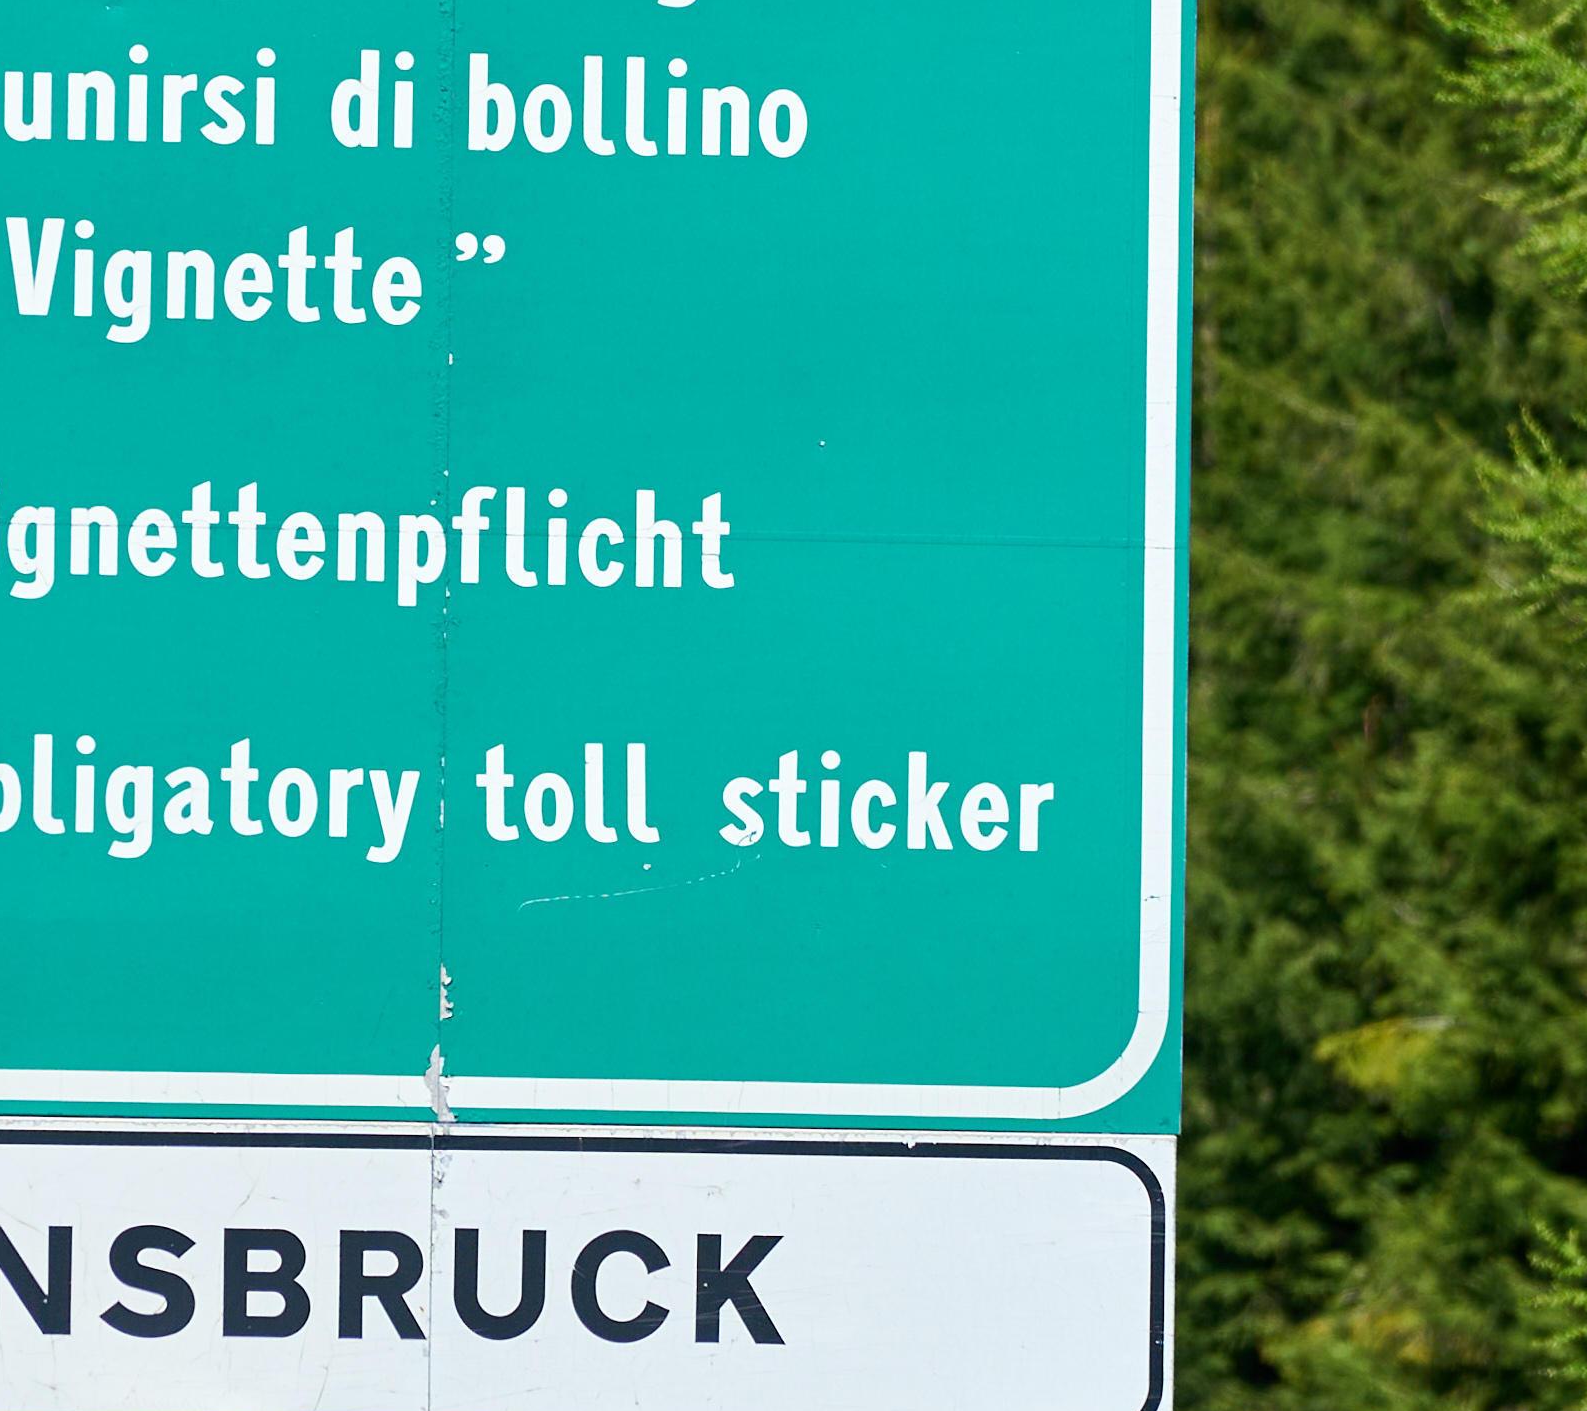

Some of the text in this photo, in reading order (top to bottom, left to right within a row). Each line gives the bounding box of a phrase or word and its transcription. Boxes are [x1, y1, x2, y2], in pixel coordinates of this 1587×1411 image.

[330, 49, 415, 149] di
[467, 52, 809, 159] bollino
[475, 742, 661, 845] toll
[719, 749, 1055, 853] sticker
